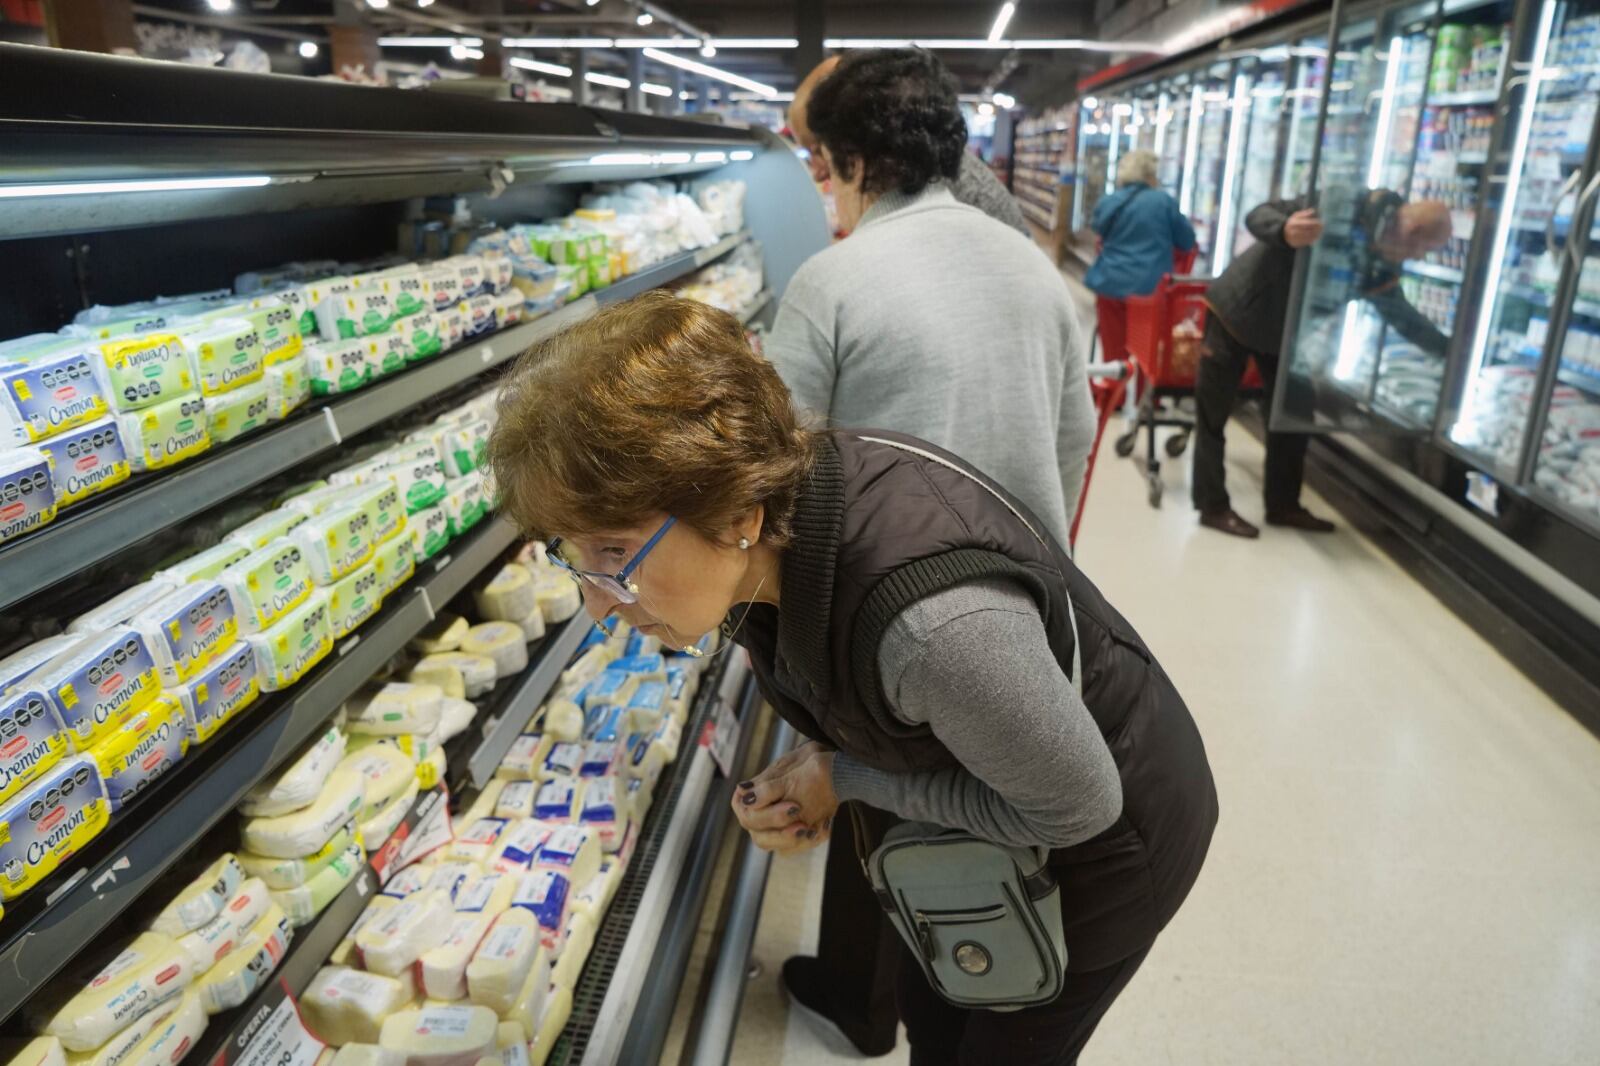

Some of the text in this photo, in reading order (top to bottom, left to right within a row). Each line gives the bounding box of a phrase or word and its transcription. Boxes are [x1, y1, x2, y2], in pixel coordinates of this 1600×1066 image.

[48, 395, 96, 426] Cremón
[67, 463, 114, 495] Cremón
[0, 510, 41, 538] emón
[190, 621, 226, 660] Cremón
[94, 676, 143, 724] Cremón
[125, 722, 170, 768] Cremón
[26, 807, 86, 866] Cremón
[237, 1004, 272, 1048] OFERTA
